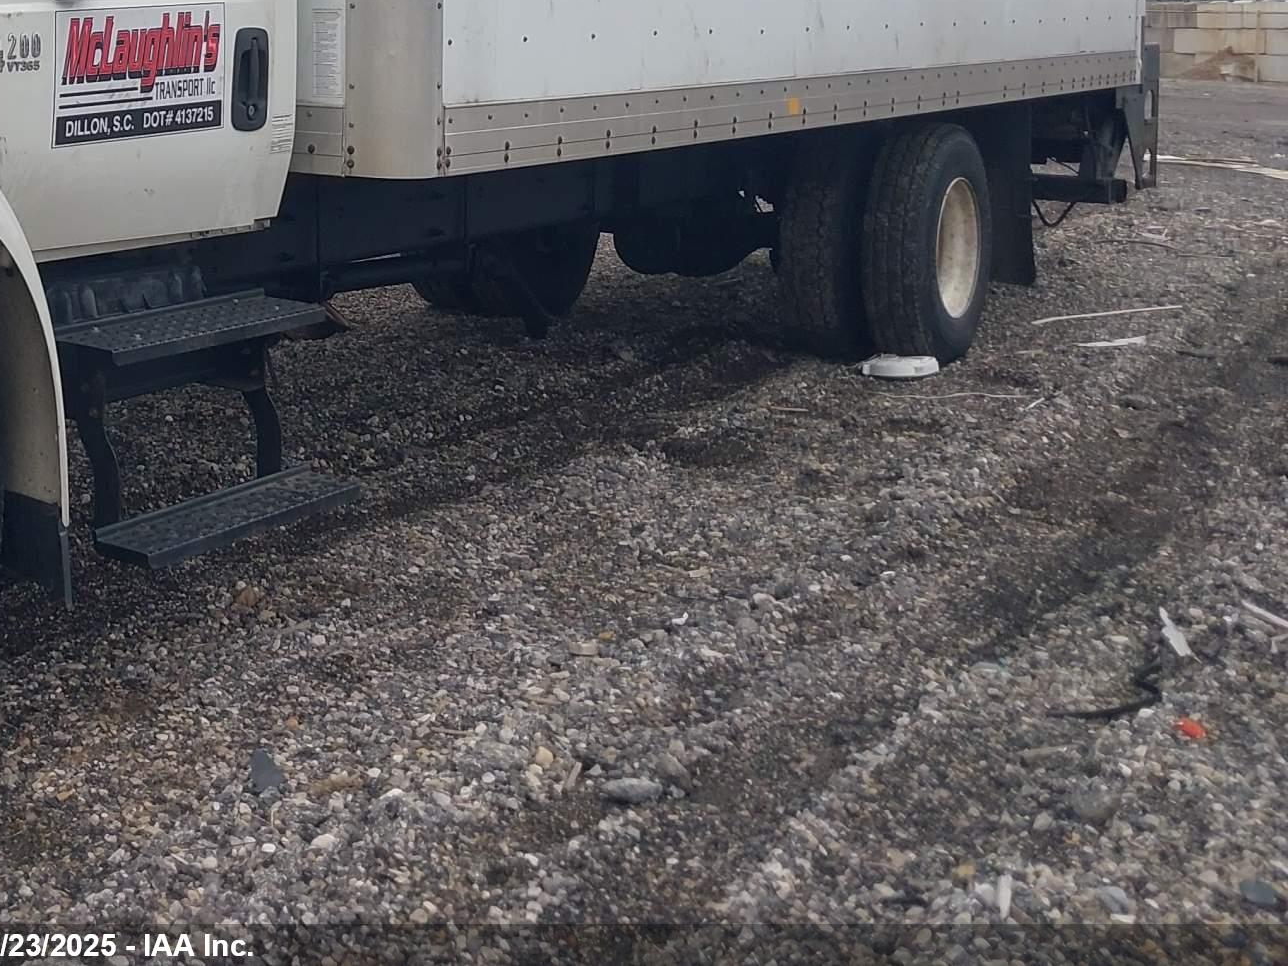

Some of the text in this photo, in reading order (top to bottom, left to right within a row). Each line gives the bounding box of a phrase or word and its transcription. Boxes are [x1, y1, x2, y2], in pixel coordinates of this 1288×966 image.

[62, 10, 221, 93] McLaughlin's
[7, 60, 40, 72] VT365
[155, 78, 204, 100] TRANSPORT
[65, 106, 214, 137] DILLON, S.C. DOT# 4137215
